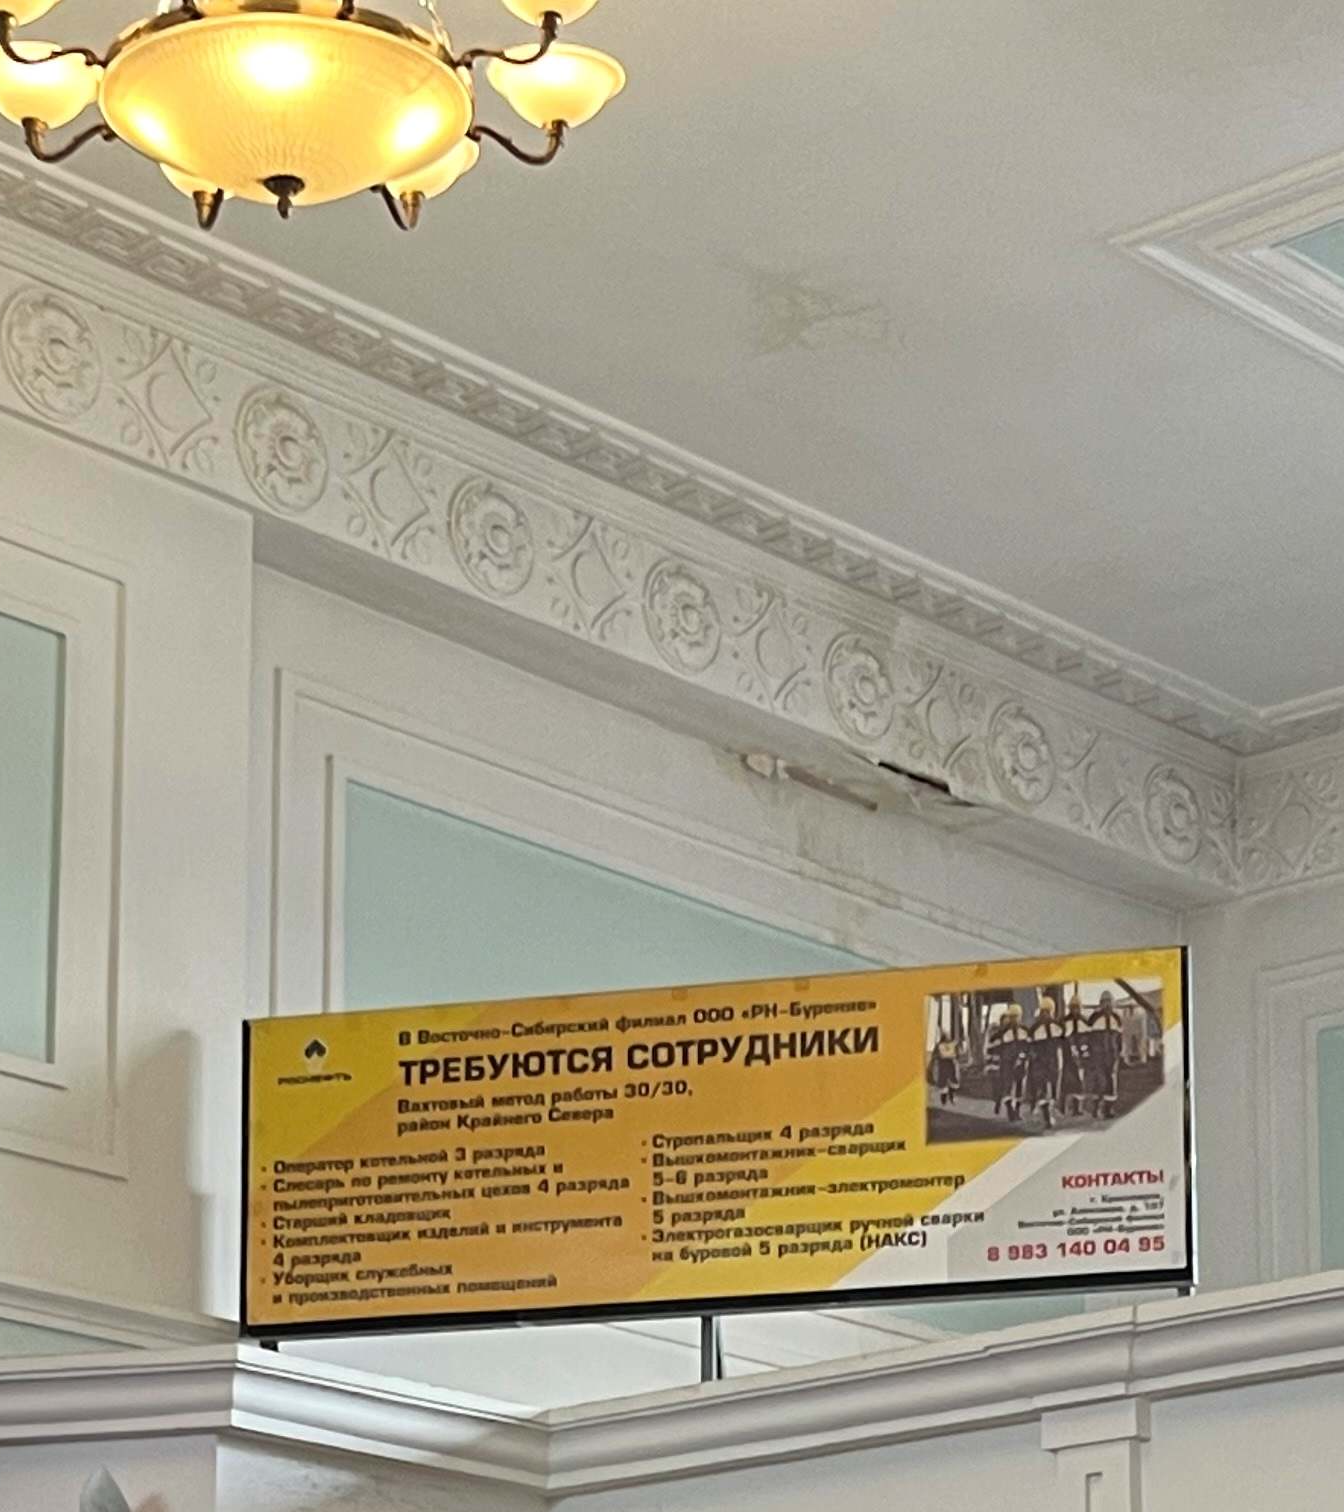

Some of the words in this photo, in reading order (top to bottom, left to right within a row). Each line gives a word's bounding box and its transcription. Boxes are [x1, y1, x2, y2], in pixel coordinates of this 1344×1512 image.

[398, 1030, 411, 1046] В
[418, 1017, 609, 1045] Восточно-Сибирский
[615, 1013, 687, 1034] филиал
[693, 1006, 735, 1024] ООО
[399, 1045, 613, 1087] ТРЕБУЮТСЯ
[627, 1026, 880, 1070] СОТРУДНИКИ
[397, 1095, 485, 1114] Вахтовый
[491, 1092, 546, 1107] метод
[551, 1085, 618, 1107] работы
[624, 1079, 694, 1099] 30/30,
[397, 1119, 450, 1137] район
[457, 1111, 542, 1132] Крайнего
[548, 1105, 614, 1124] Севера
[652, 1127, 772, 1150] Стропальщик
[780, 1125, 792, 1140] 4
[799, 1121, 875, 1142] разряда
[273, 1159, 354, 1175] Оператор
[360, 1149, 449, 1168] котельной
[455, 1147, 467, 1161] 3
[473, 1143, 546, 1163] разряда
[273, 1177, 345, 1194] Слесарь
[351, 1175, 372, 1188] по
[377, 1169, 449, 1190] ремонту
[454, 1163, 547, 1180] котельных
[553, 1162, 564, 1174] и
[694, 1167, 769, 1187] разряда
[1062, 1169, 1165, 1190] КОНТАКТЫ
[273, 1187, 475, 1213] пылеприготовительных
[481, 1181, 532, 1199] цехов
[537, 1178, 550, 1194] 4
[556, 1177, 631, 1196] разряда
[273, 1212, 349, 1232] Старший
[354, 1206, 452, 1225] кладовщик
[273, 1230, 411, 1250] Комплектовщик
[417, 1221, 489, 1240] изделий
[496, 1223, 507, 1235] и
[512, 1214, 624, 1234] инструмента
[652, 1220, 843, 1245] Электрогазосварщик
[850, 1214, 914, 1233] ручной
[921, 1210, 986, 1229] сварки
[653, 1209, 665, 1225] 5
[671, 1207, 747, 1227] разряда
[273, 1253, 285, 1267] 4
[290, 1249, 362, 1269] разряда
[652, 1249, 674, 1262] на
[680, 1241, 752, 1264] буровой
[759, 1240, 771, 1255] 5
[777, 1237, 853, 1258] разряда
[860, 1230, 928, 1250] (НАКС)
[1057, 1240, 1097, 1258] 140
[1103, 1237, 1131, 1254] 04
[1138, 1235, 1166, 1252] 95
[273, 1270, 349, 1288] Уборщик
[355, 1263, 454, 1283] служебных
[288, 1283, 451, 1306] производственных
[456, 1275, 558, 1294] помещений
